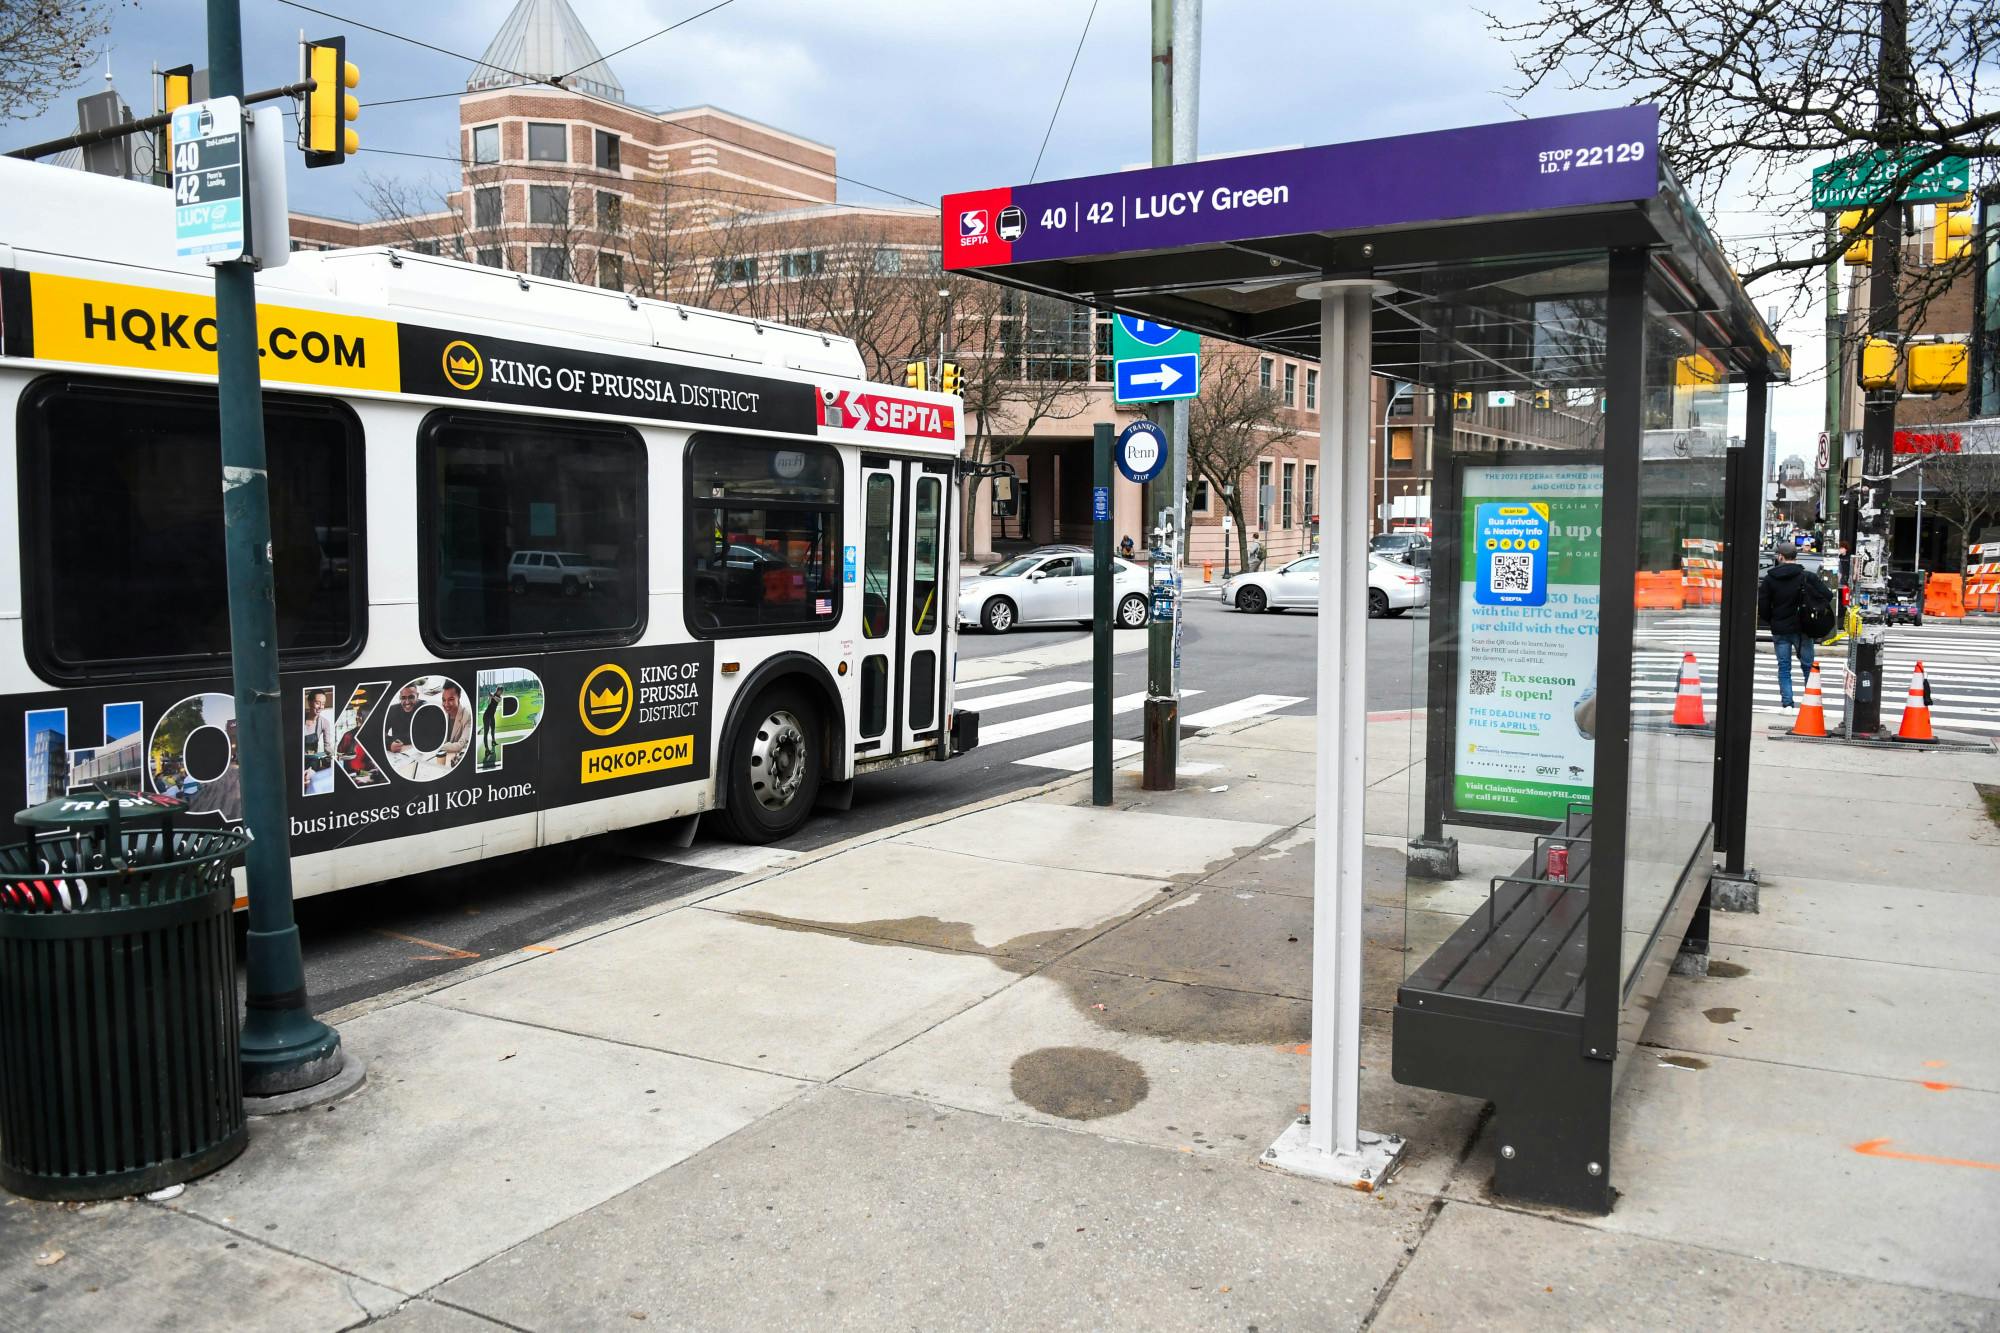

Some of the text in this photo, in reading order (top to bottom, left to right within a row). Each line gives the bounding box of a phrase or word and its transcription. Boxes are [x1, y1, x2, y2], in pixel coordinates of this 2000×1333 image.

[176, 141, 199, 172] 40
[1538, 149, 1573, 163] STOP
[1575, 141, 1645, 168] 22129
[1540, 162, 1560, 174] I.D.
[176, 175, 200, 204] 42
[1815, 184, 1911, 201] Univery
[1040, 184, 1289, 230] 40 42 LUCY Green
[177, 207, 210, 227] LUCY
[960, 236, 989, 247] SEPTA
[83, 302, 366, 369] HQKO.COM
[490, 358, 760, 413] KING OF PRUSSIA DISTRICT
[874, 400, 942, 434] SEPTA
[1127, 422, 1157, 434] TRANSIT
[1127, 445, 1155, 459] Penn
[1132, 473, 1150, 481] STOP
[1488, 517, 1539, 526] Bus Arrivals
[1493, 527, 1524, 537] Nearby
[1525, 527, 1543, 536] Info
[1566, 524, 1592, 541] up
[1472, 606, 1498, 616] with
[1501, 607, 1520, 617] the
[1522, 608, 1552, 618] EITC
[1554, 608, 1578, 619] and
[1471, 623, 1493, 632] per
[1494, 622, 1523, 632] child
[1525, 622, 1552, 634] with
[1555, 624, 1575, 634] the
[639, 662, 700, 684] KING OF
[1502, 671, 1576, 686] Tax season
[638, 682, 699, 705] PRUSSIA
[1500, 686, 1553, 701] is open!
[638, 701, 699, 724] DISTRICT
[1469, 707, 1552, 721] THE DEADLINE TO
[1469, 719, 1488, 727] FILE
[1490, 720, 1498, 728] IS
[1500, 720, 1527, 730] APRIL
[587, 743, 688, 775] HQKOP.COM
[1465, 781, 1591, 801] Visit ClaimYourMoneyPHL.com
[1475, 793, 1491, 801] call
[60, 796, 153, 812] TRASH
[290, 782, 537, 838] businesses call KOP home.
